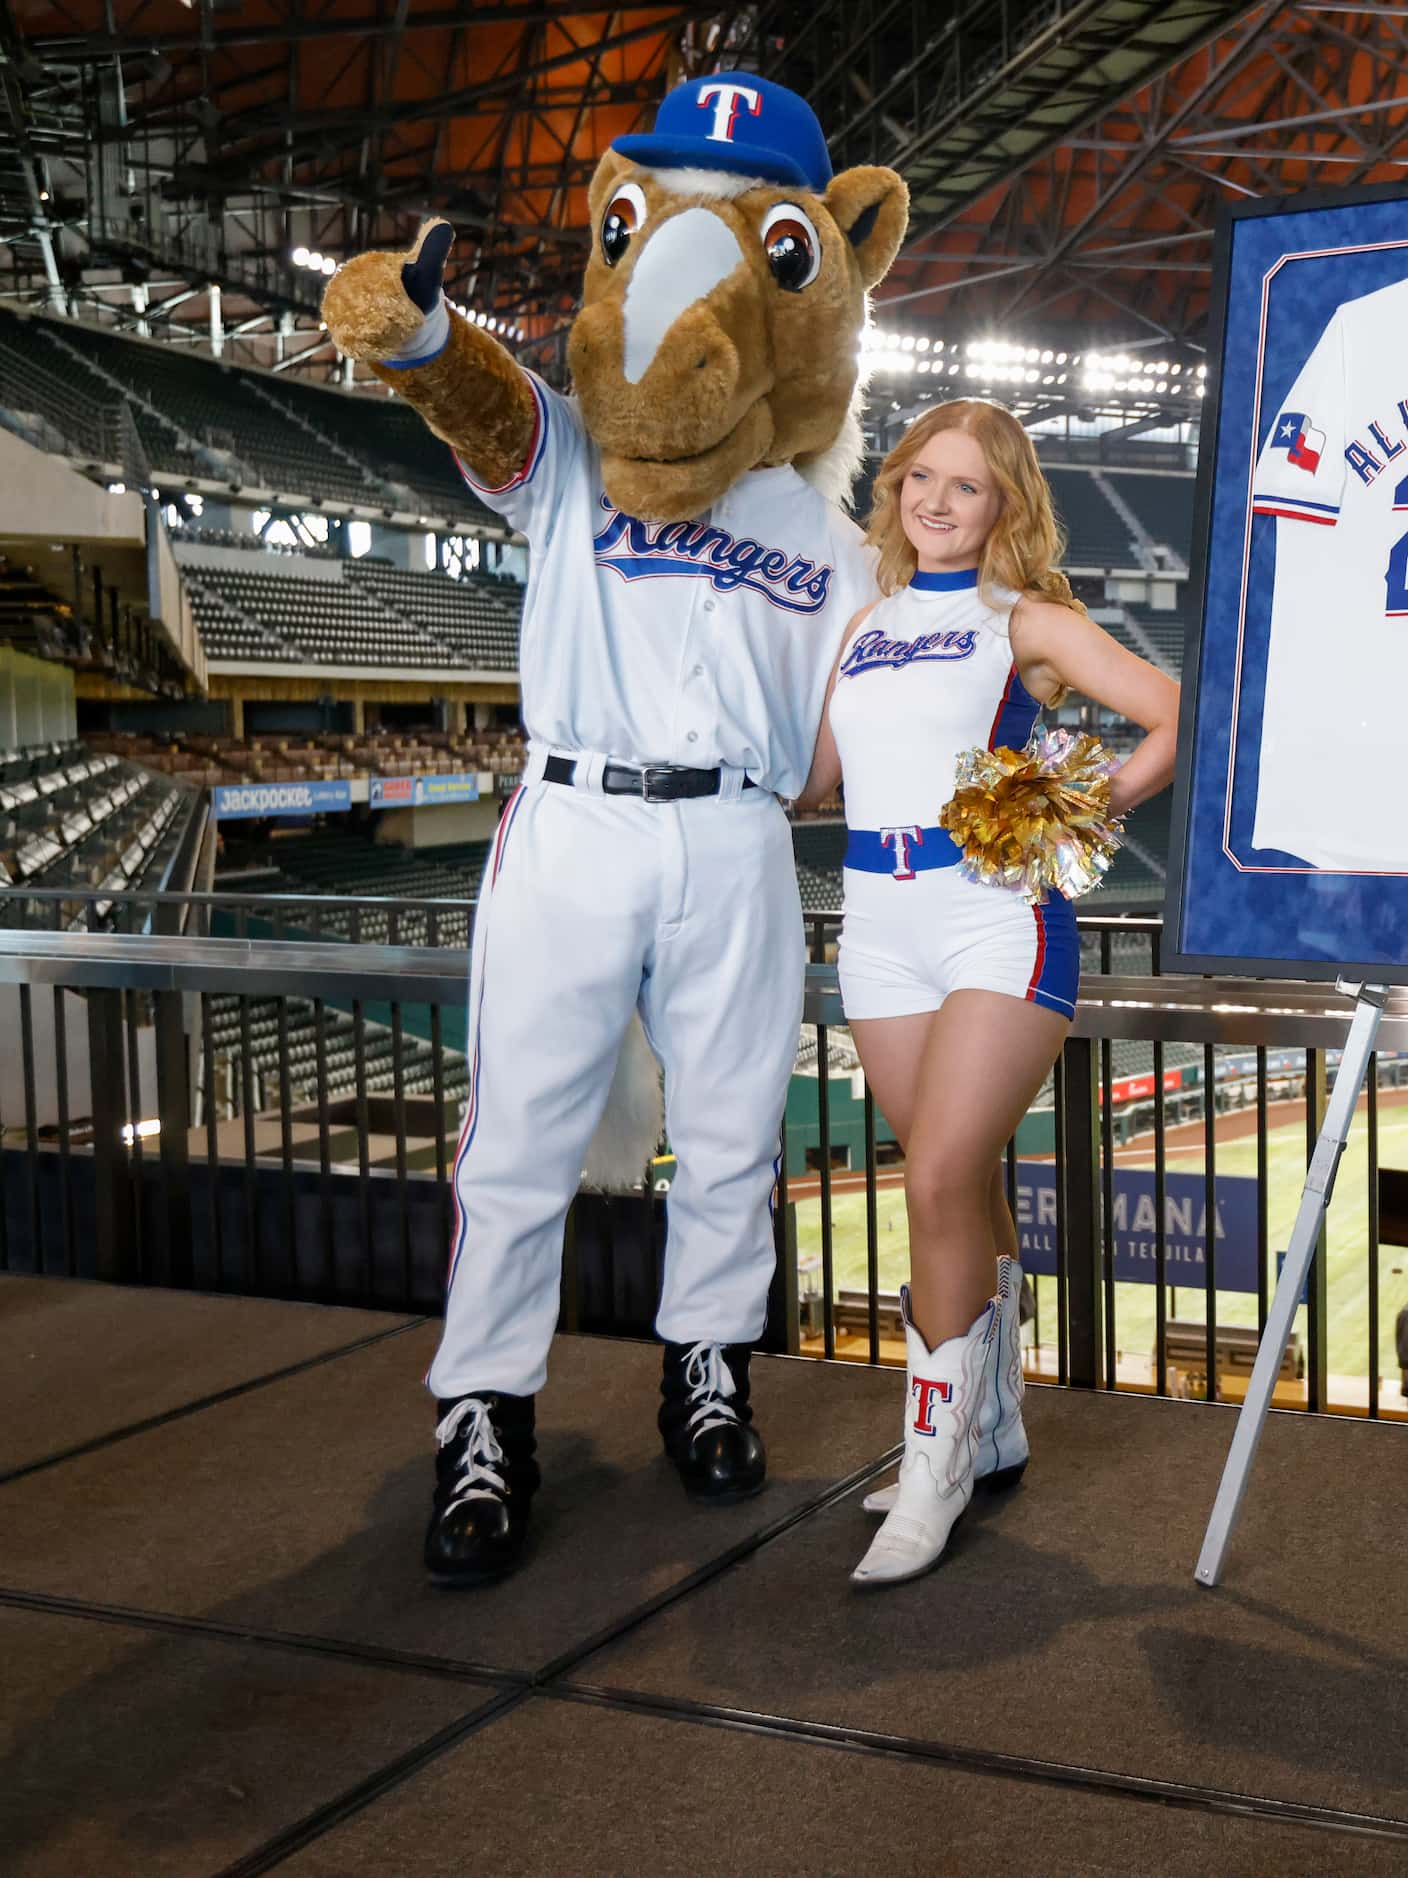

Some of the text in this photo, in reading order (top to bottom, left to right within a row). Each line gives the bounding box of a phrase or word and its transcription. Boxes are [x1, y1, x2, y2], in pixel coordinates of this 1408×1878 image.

[696, 83, 763, 143] T
[839, 629, 980, 678] Rangers
[880, 825, 923, 881] T
[1015, 1185, 1226, 1239] ERMANA
[912, 1376, 953, 1437] T
